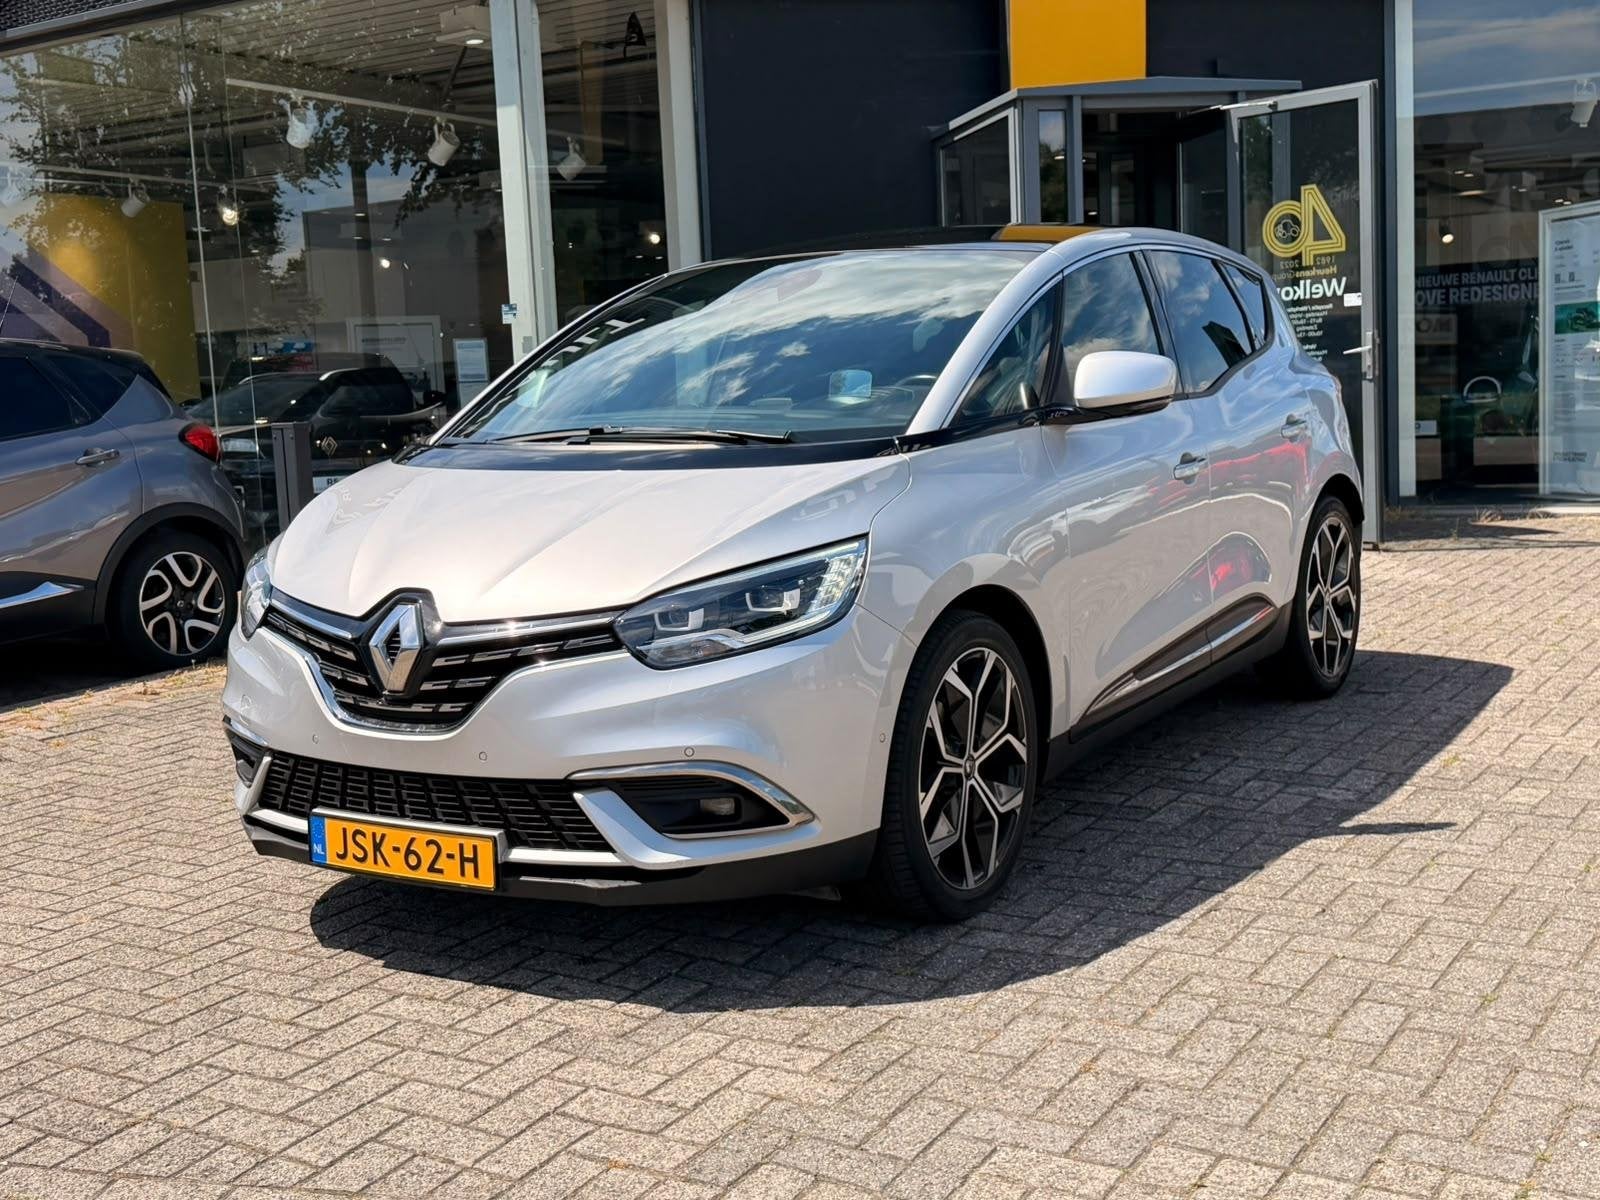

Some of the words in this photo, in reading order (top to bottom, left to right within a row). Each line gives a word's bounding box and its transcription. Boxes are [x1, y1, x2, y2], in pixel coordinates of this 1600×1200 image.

[1461, 269, 1517, 284] RENAULT
[313, 843, 325, 855] NL
[335, 827, 480, 880] JSK-62-H
